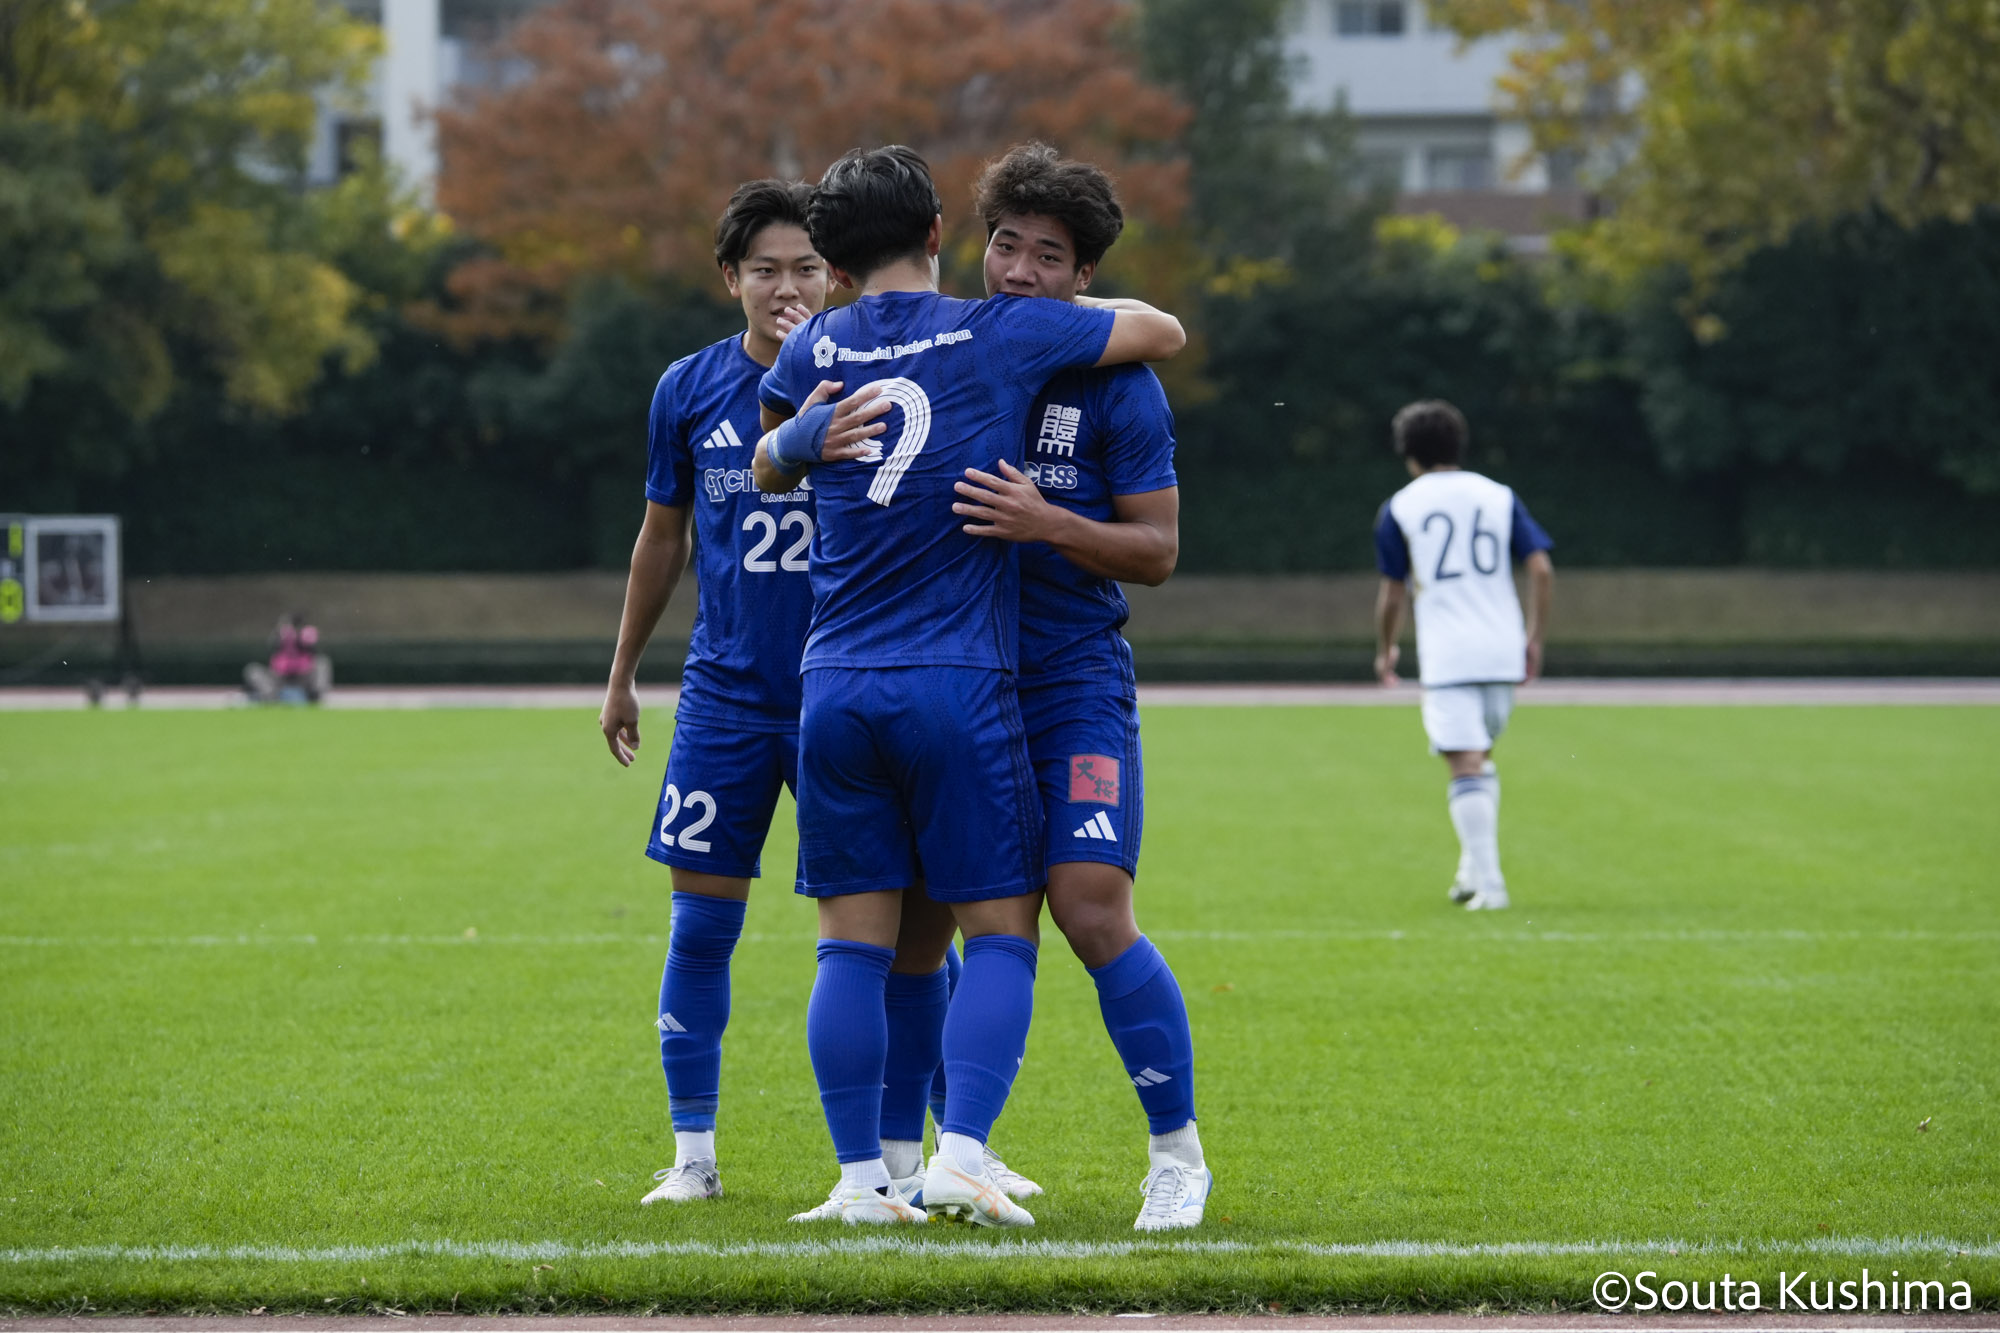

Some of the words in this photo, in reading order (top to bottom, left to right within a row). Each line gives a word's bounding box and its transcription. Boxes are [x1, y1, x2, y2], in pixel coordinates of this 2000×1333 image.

[837, 347, 892, 362] Financial
[893, 339, 933, 359] Design
[935, 329, 973, 346] Japan
[760, 492, 809, 503] SAGAMI
[742, 510, 814, 572] 22
[1423, 508, 1499, 580] 26
[660, 783, 717, 853] 22
